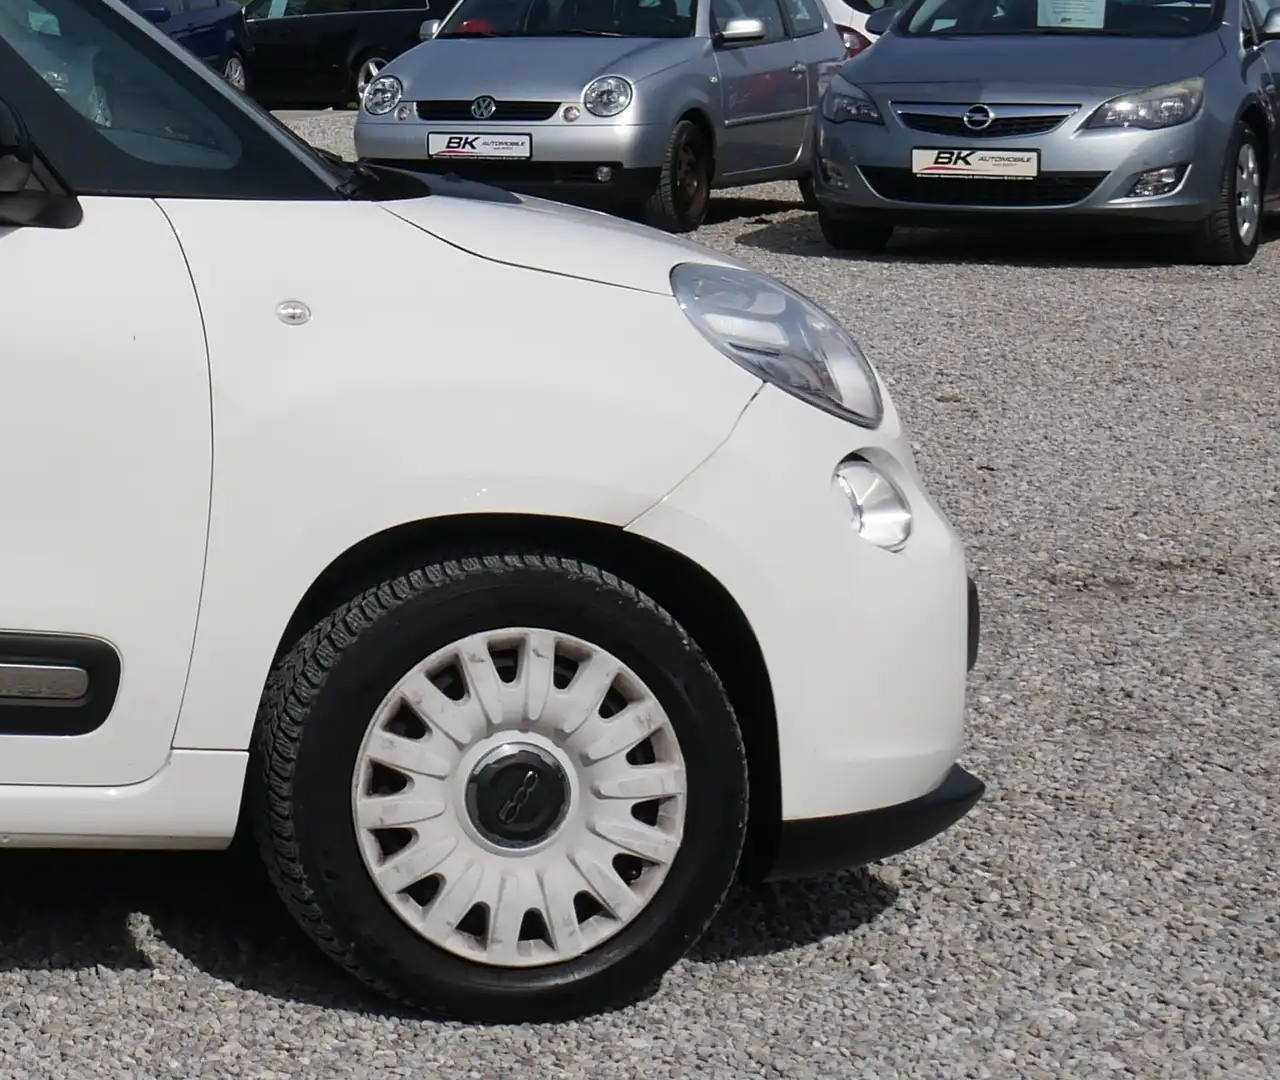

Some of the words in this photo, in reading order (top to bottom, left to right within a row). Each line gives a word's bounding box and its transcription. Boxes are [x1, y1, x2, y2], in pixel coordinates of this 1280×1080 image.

[445, 136, 481, 150] BK
[933, 150, 976, 166] BK
[978, 155, 1032, 164] AUTOMOBILE
